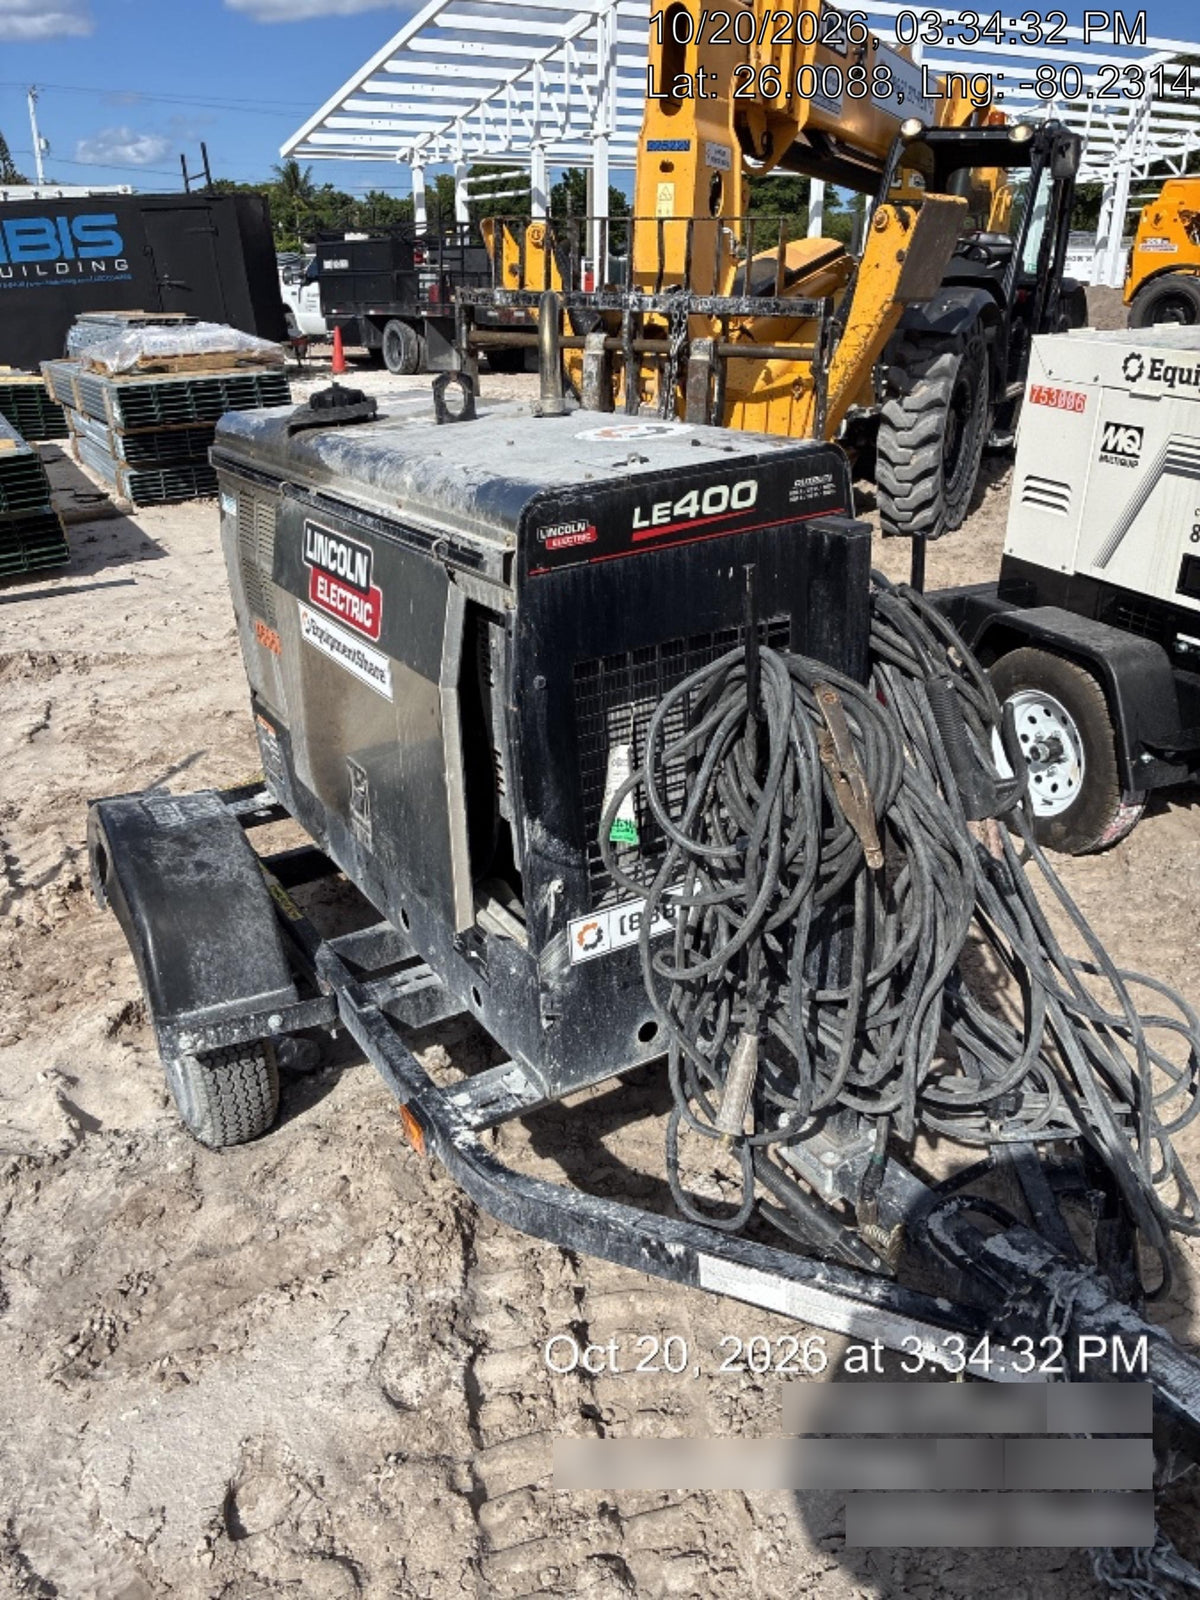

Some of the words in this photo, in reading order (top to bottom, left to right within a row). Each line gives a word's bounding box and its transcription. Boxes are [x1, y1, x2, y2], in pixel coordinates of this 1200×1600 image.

[1101, 423, 1142, 456] MQ
[632, 479, 759, 530] LE400
[538, 521, 588, 541] LINCOLN
[550, 532, 593, 548] ELECTRIC
[304, 526, 370, 589] LINCOLN
[316, 575, 373, 629] ELECTRIC
